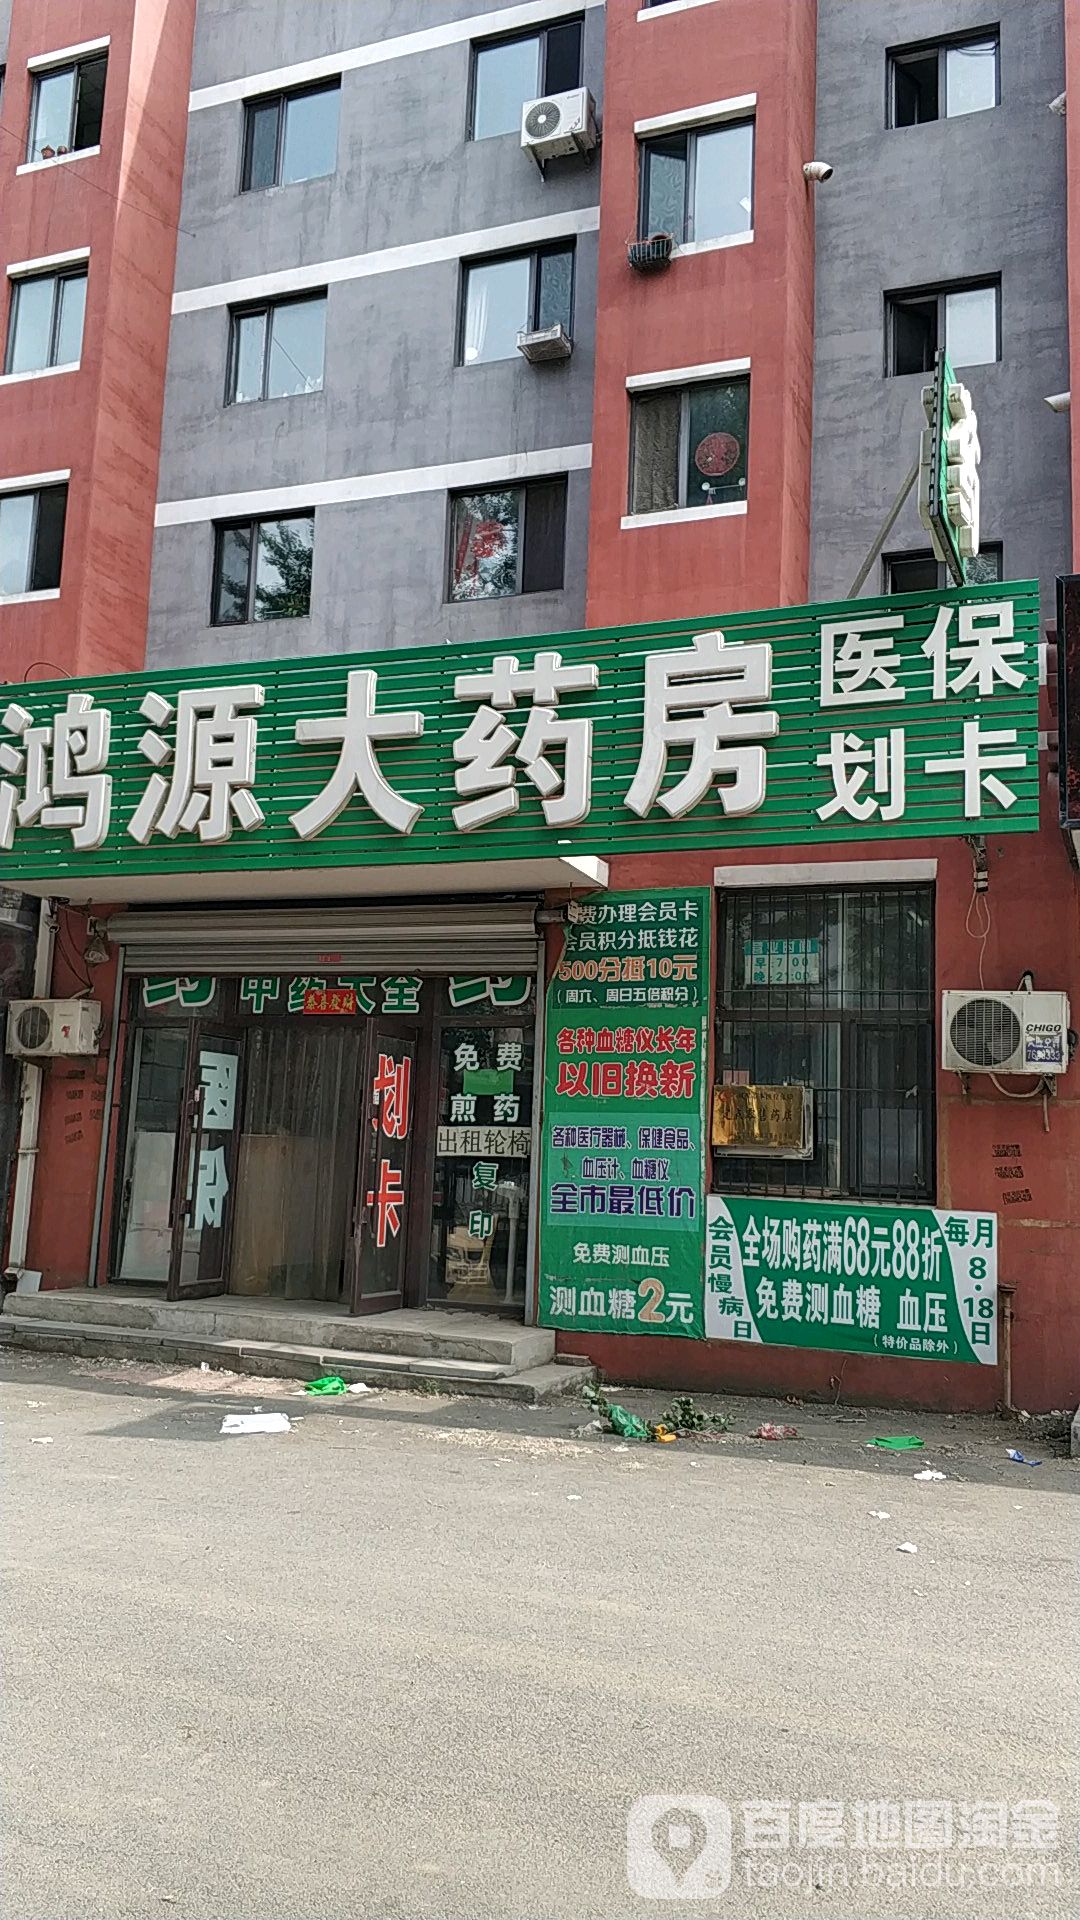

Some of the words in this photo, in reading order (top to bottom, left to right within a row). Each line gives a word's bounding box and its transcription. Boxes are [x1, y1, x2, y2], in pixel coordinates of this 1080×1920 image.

[820, 600, 1027, 707] 医保
[0, 632, 780, 849] 鸿源大药房
[816, 721, 1027, 822] 划卡
[579, 900, 699, 924] 费办理会员卡
[558, 954, 698, 982] 500分抵10元
[556, 1026, 697, 1054] 各种血糖仪长年
[1025, 1023, 1062, 1032] CHIGO
[453, 1042, 523, 1072] 免费
[555, 1059, 696, 1099] 以旧换新
[450, 1093, 520, 1123] 煎药
[437, 1127, 531, 1157] 出租轮椅
[582, 1156, 670, 1181] 血压计、血糖仪
[469, 1161, 498, 1240] 复印
[550, 1183, 697, 1219] 全市最低价
[742, 1214, 943, 1282] 全场购药满68元88折
[944, 1216, 993, 1249] 每月
[572, 1242, 670, 1267] 免费测血压
[549, 1277, 694, 1324] 测血糖2元
